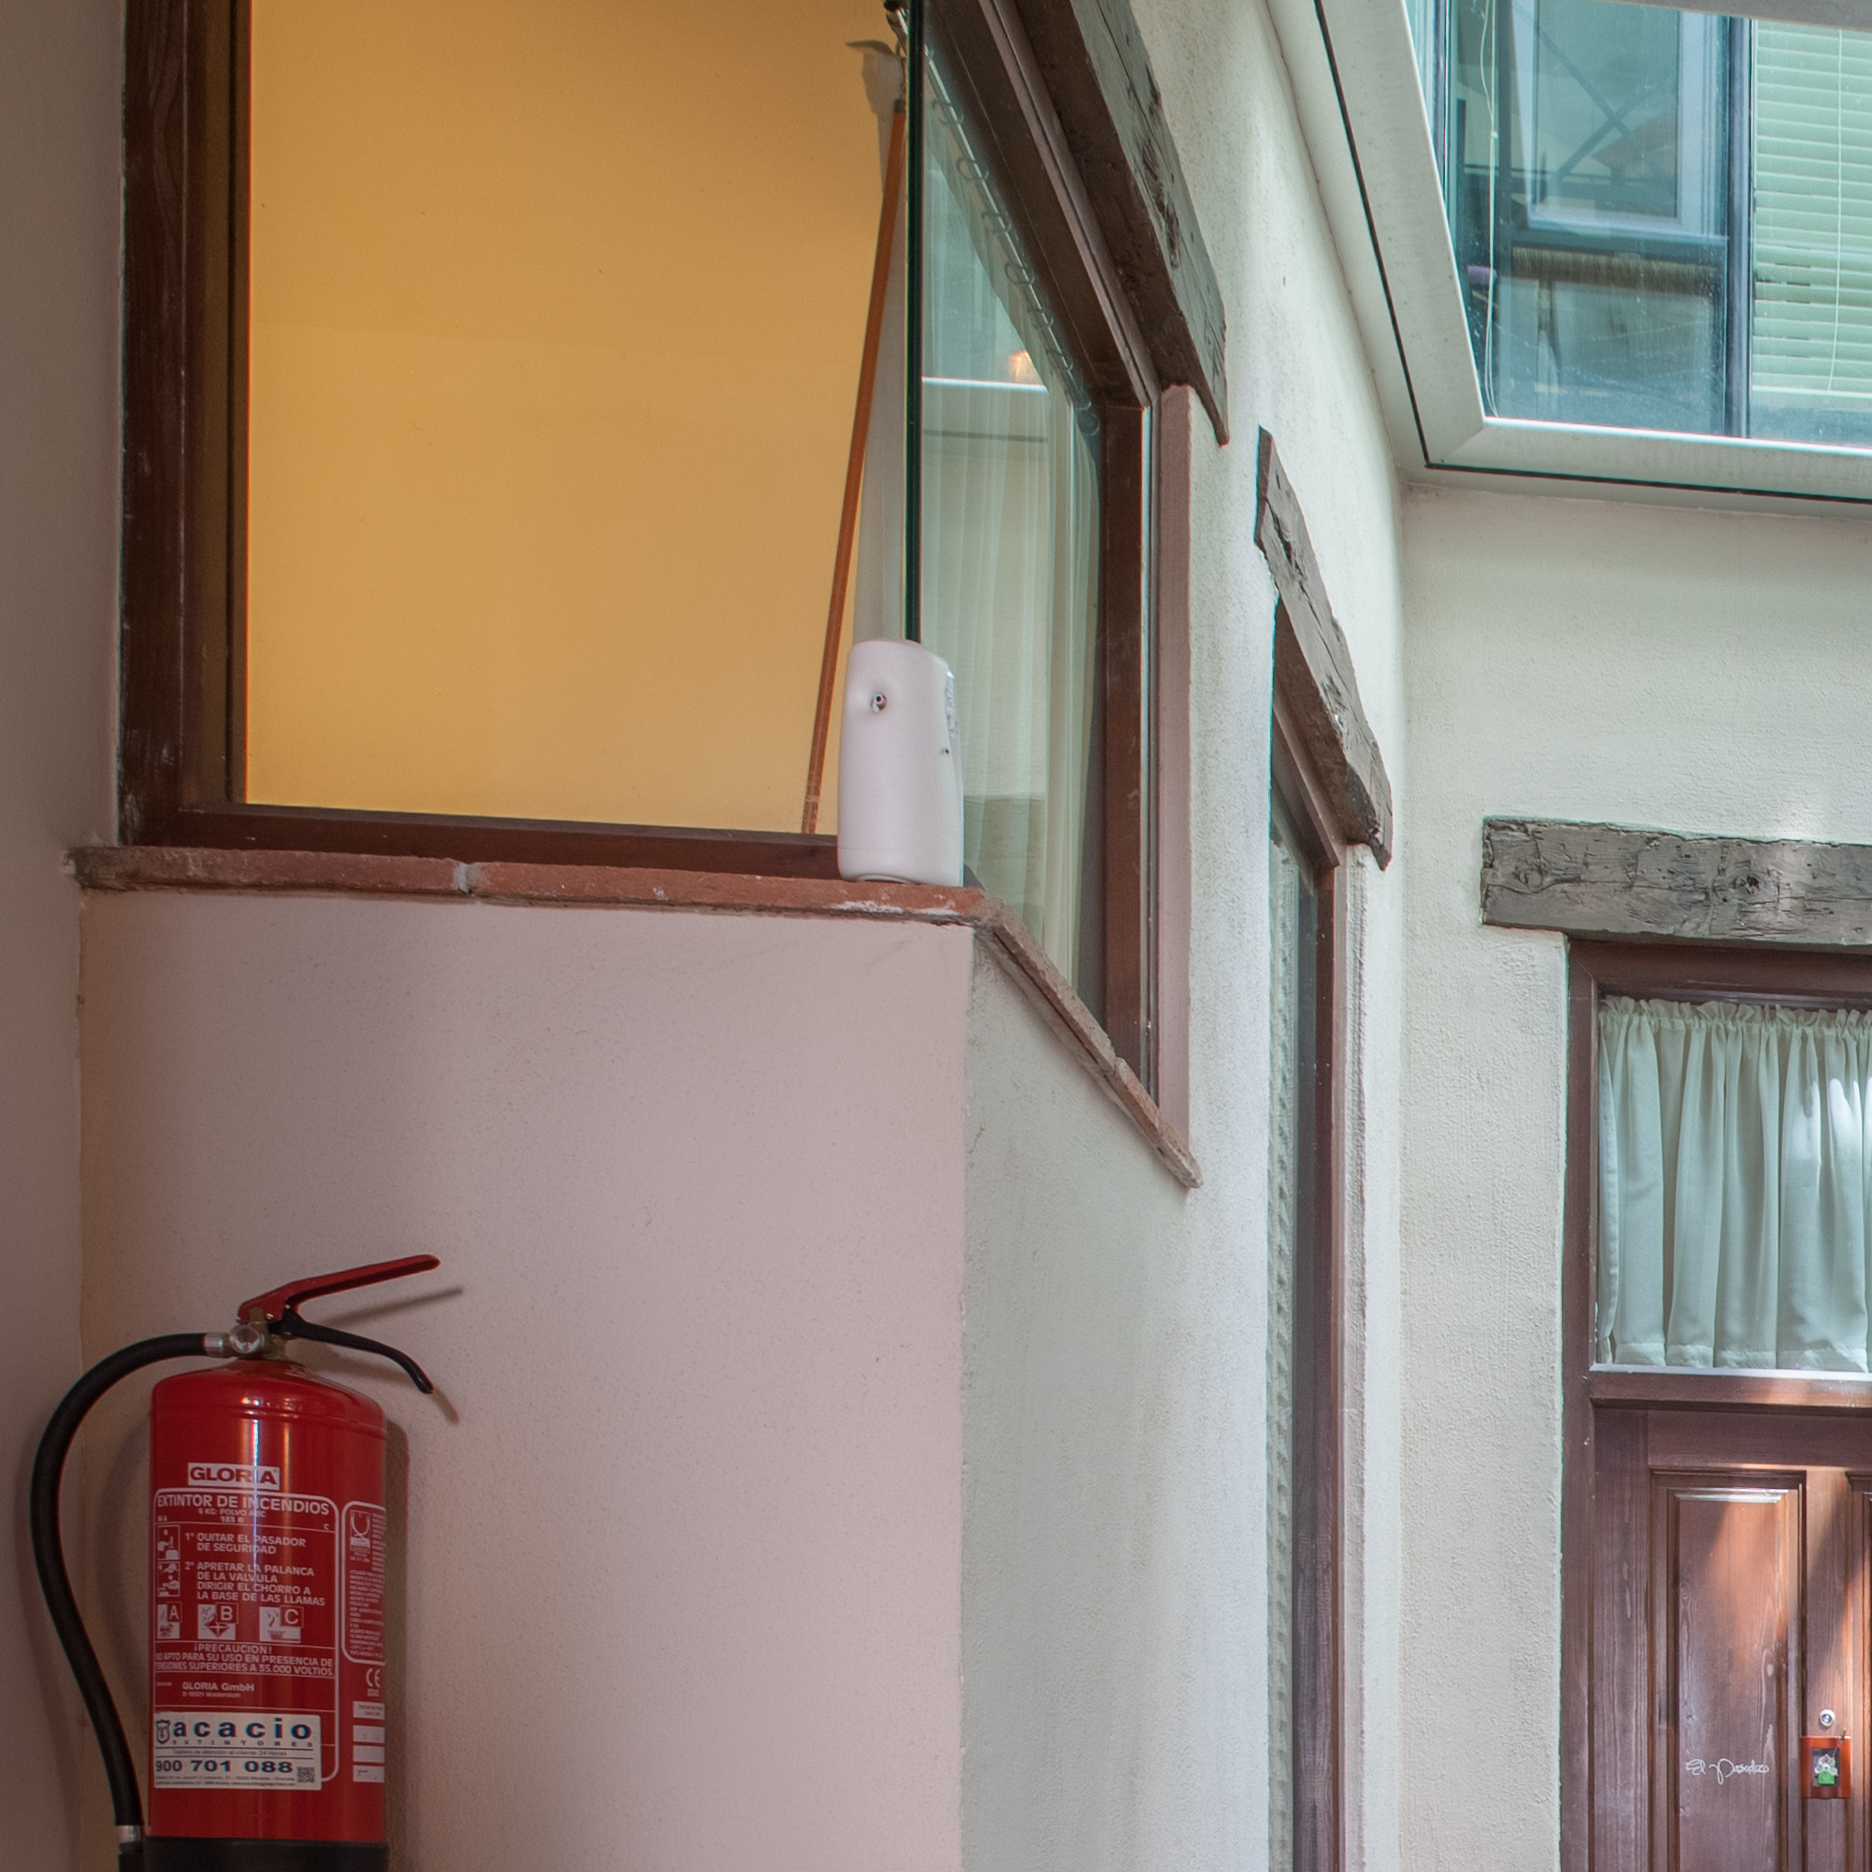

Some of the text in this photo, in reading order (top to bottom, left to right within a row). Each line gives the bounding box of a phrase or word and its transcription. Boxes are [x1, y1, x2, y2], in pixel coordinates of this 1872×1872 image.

[189, 1466, 277, 1485] GLORIA
[157, 1494, 330, 1516] EXTINTOR DE INCENDIOS
[219, 1508, 247, 1518] POLVO
[197, 1532, 307, 1548] QUITAR EL PASADOR
[197, 1542, 277, 1555] DE SEGURIDAD
[197, 1561, 315, 1577] APRETAR LA PALANCA
[197, 1571, 211, 1581] DE
[213, 1571, 227, 1581] LA
[197, 1581, 235, 1591] DIRIGIR
[237, 1582, 250, 1592] EL
[253, 1583, 301, 1595] CHORRO
[197, 1591, 326, 1607] LA BASE DE LAS LLAMAS
[169, 1605, 179, 1620] A
[220, 1606, 234, 1622] B
[284, 1609, 299, 1625] C
[182, 1652, 205, 1663] PARA
[207, 1653, 220, 1663] SU
[221, 1653, 243, 1664] USO
[245, 1655, 260, 1665] EN
[261, 1655, 318, 1668] PRESENCIA
[320, 1658, 334, 1668] DE
[188, 1662, 248, 1673] SUPERIORES
[182, 1681, 255, 1693] GLORIA GmbH
[172, 1717, 313, 1740] acacio
[172, 1739, 314, 1748] EXTINTORES
[155, 1759, 293, 1774] 900 701 088
[1685, 1758, 1706, 1776] El
